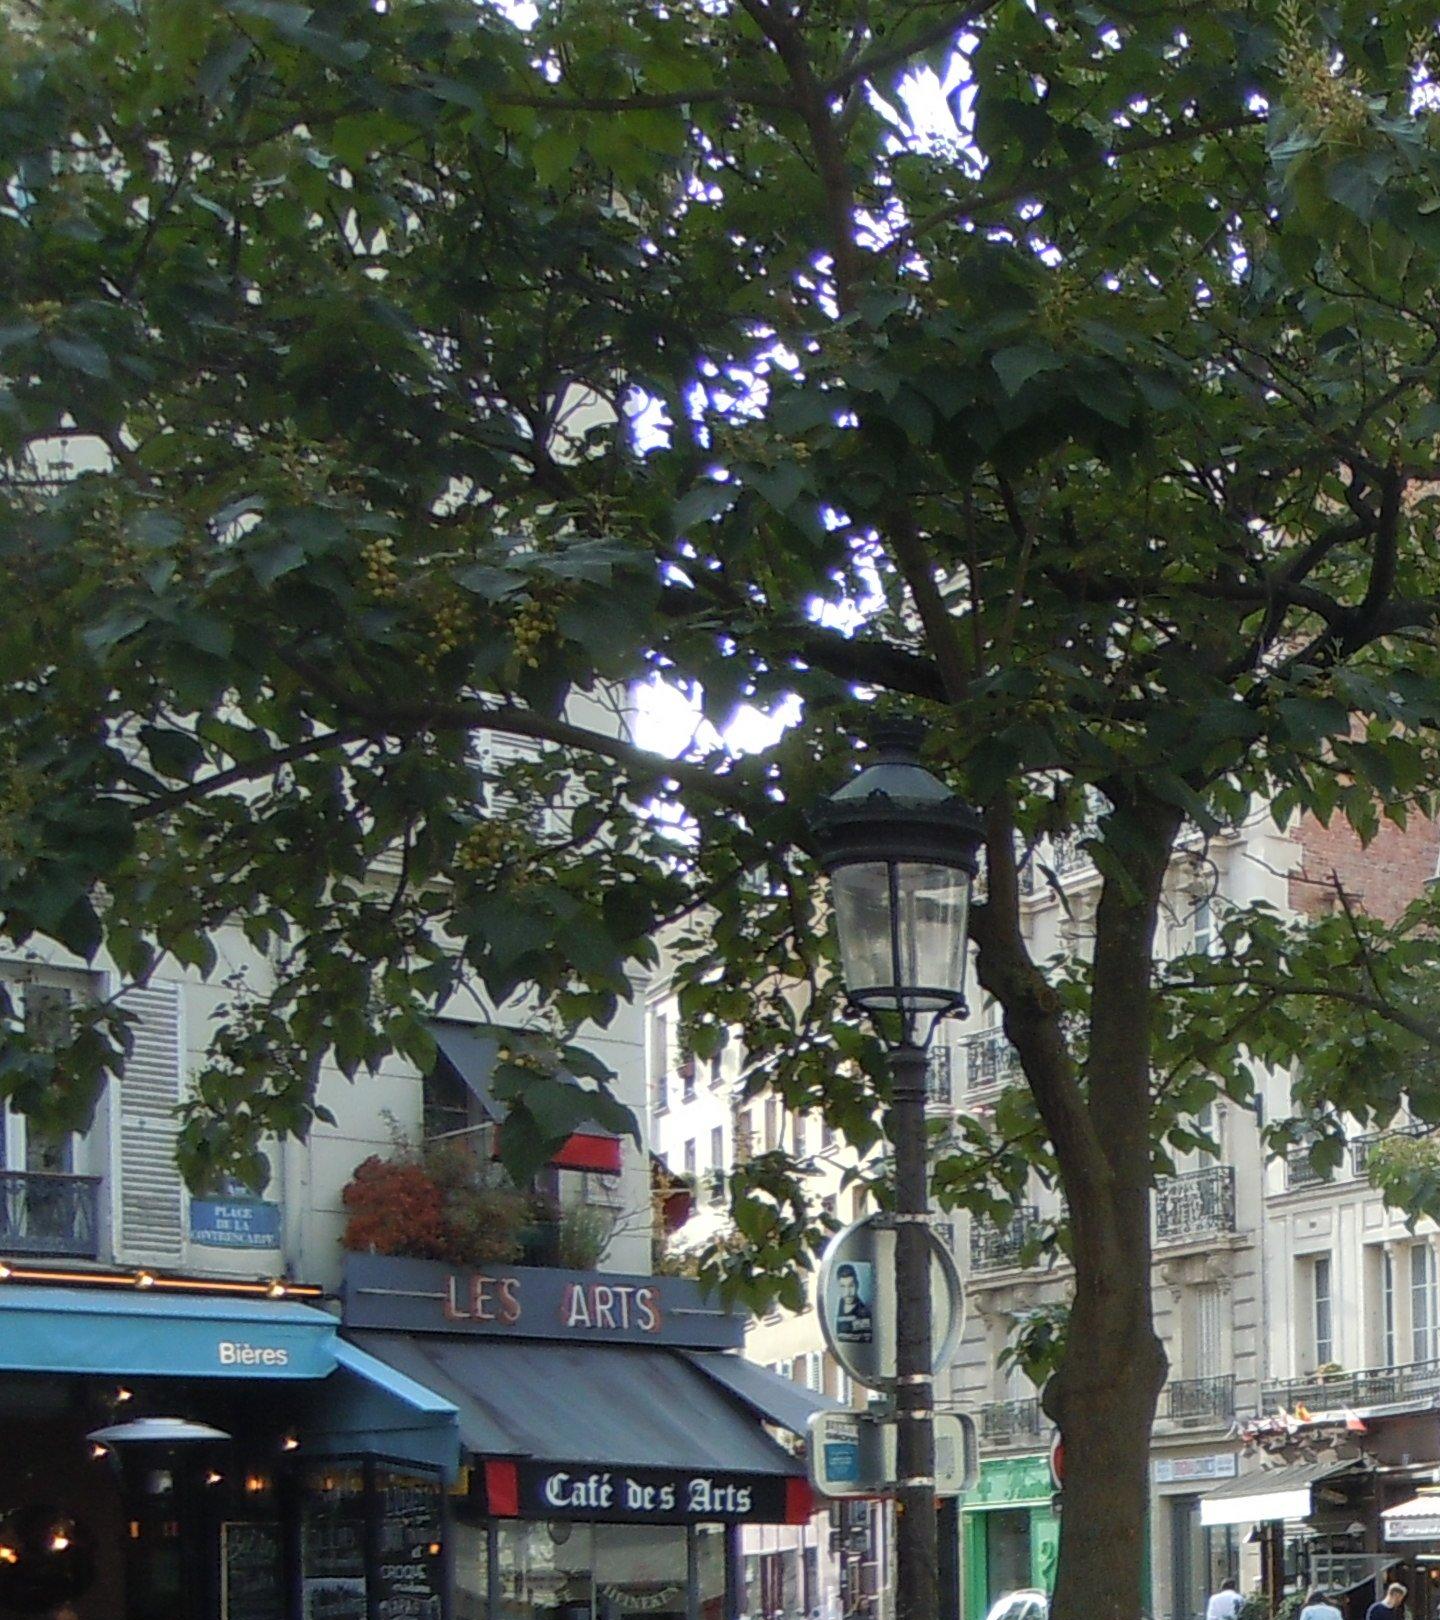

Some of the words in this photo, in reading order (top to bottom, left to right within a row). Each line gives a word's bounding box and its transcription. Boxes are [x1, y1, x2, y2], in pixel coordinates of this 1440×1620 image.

[214, 1206, 253, 1219] PLACE
[447, 1275, 522, 1321] LES
[565, 1283, 660, 1332] ARTS
[219, 1342, 288, 1365] Bières
[545, 1473, 613, 1508] Café
[626, 1478, 675, 1510] des
[687, 1478, 751, 1513] Arts
